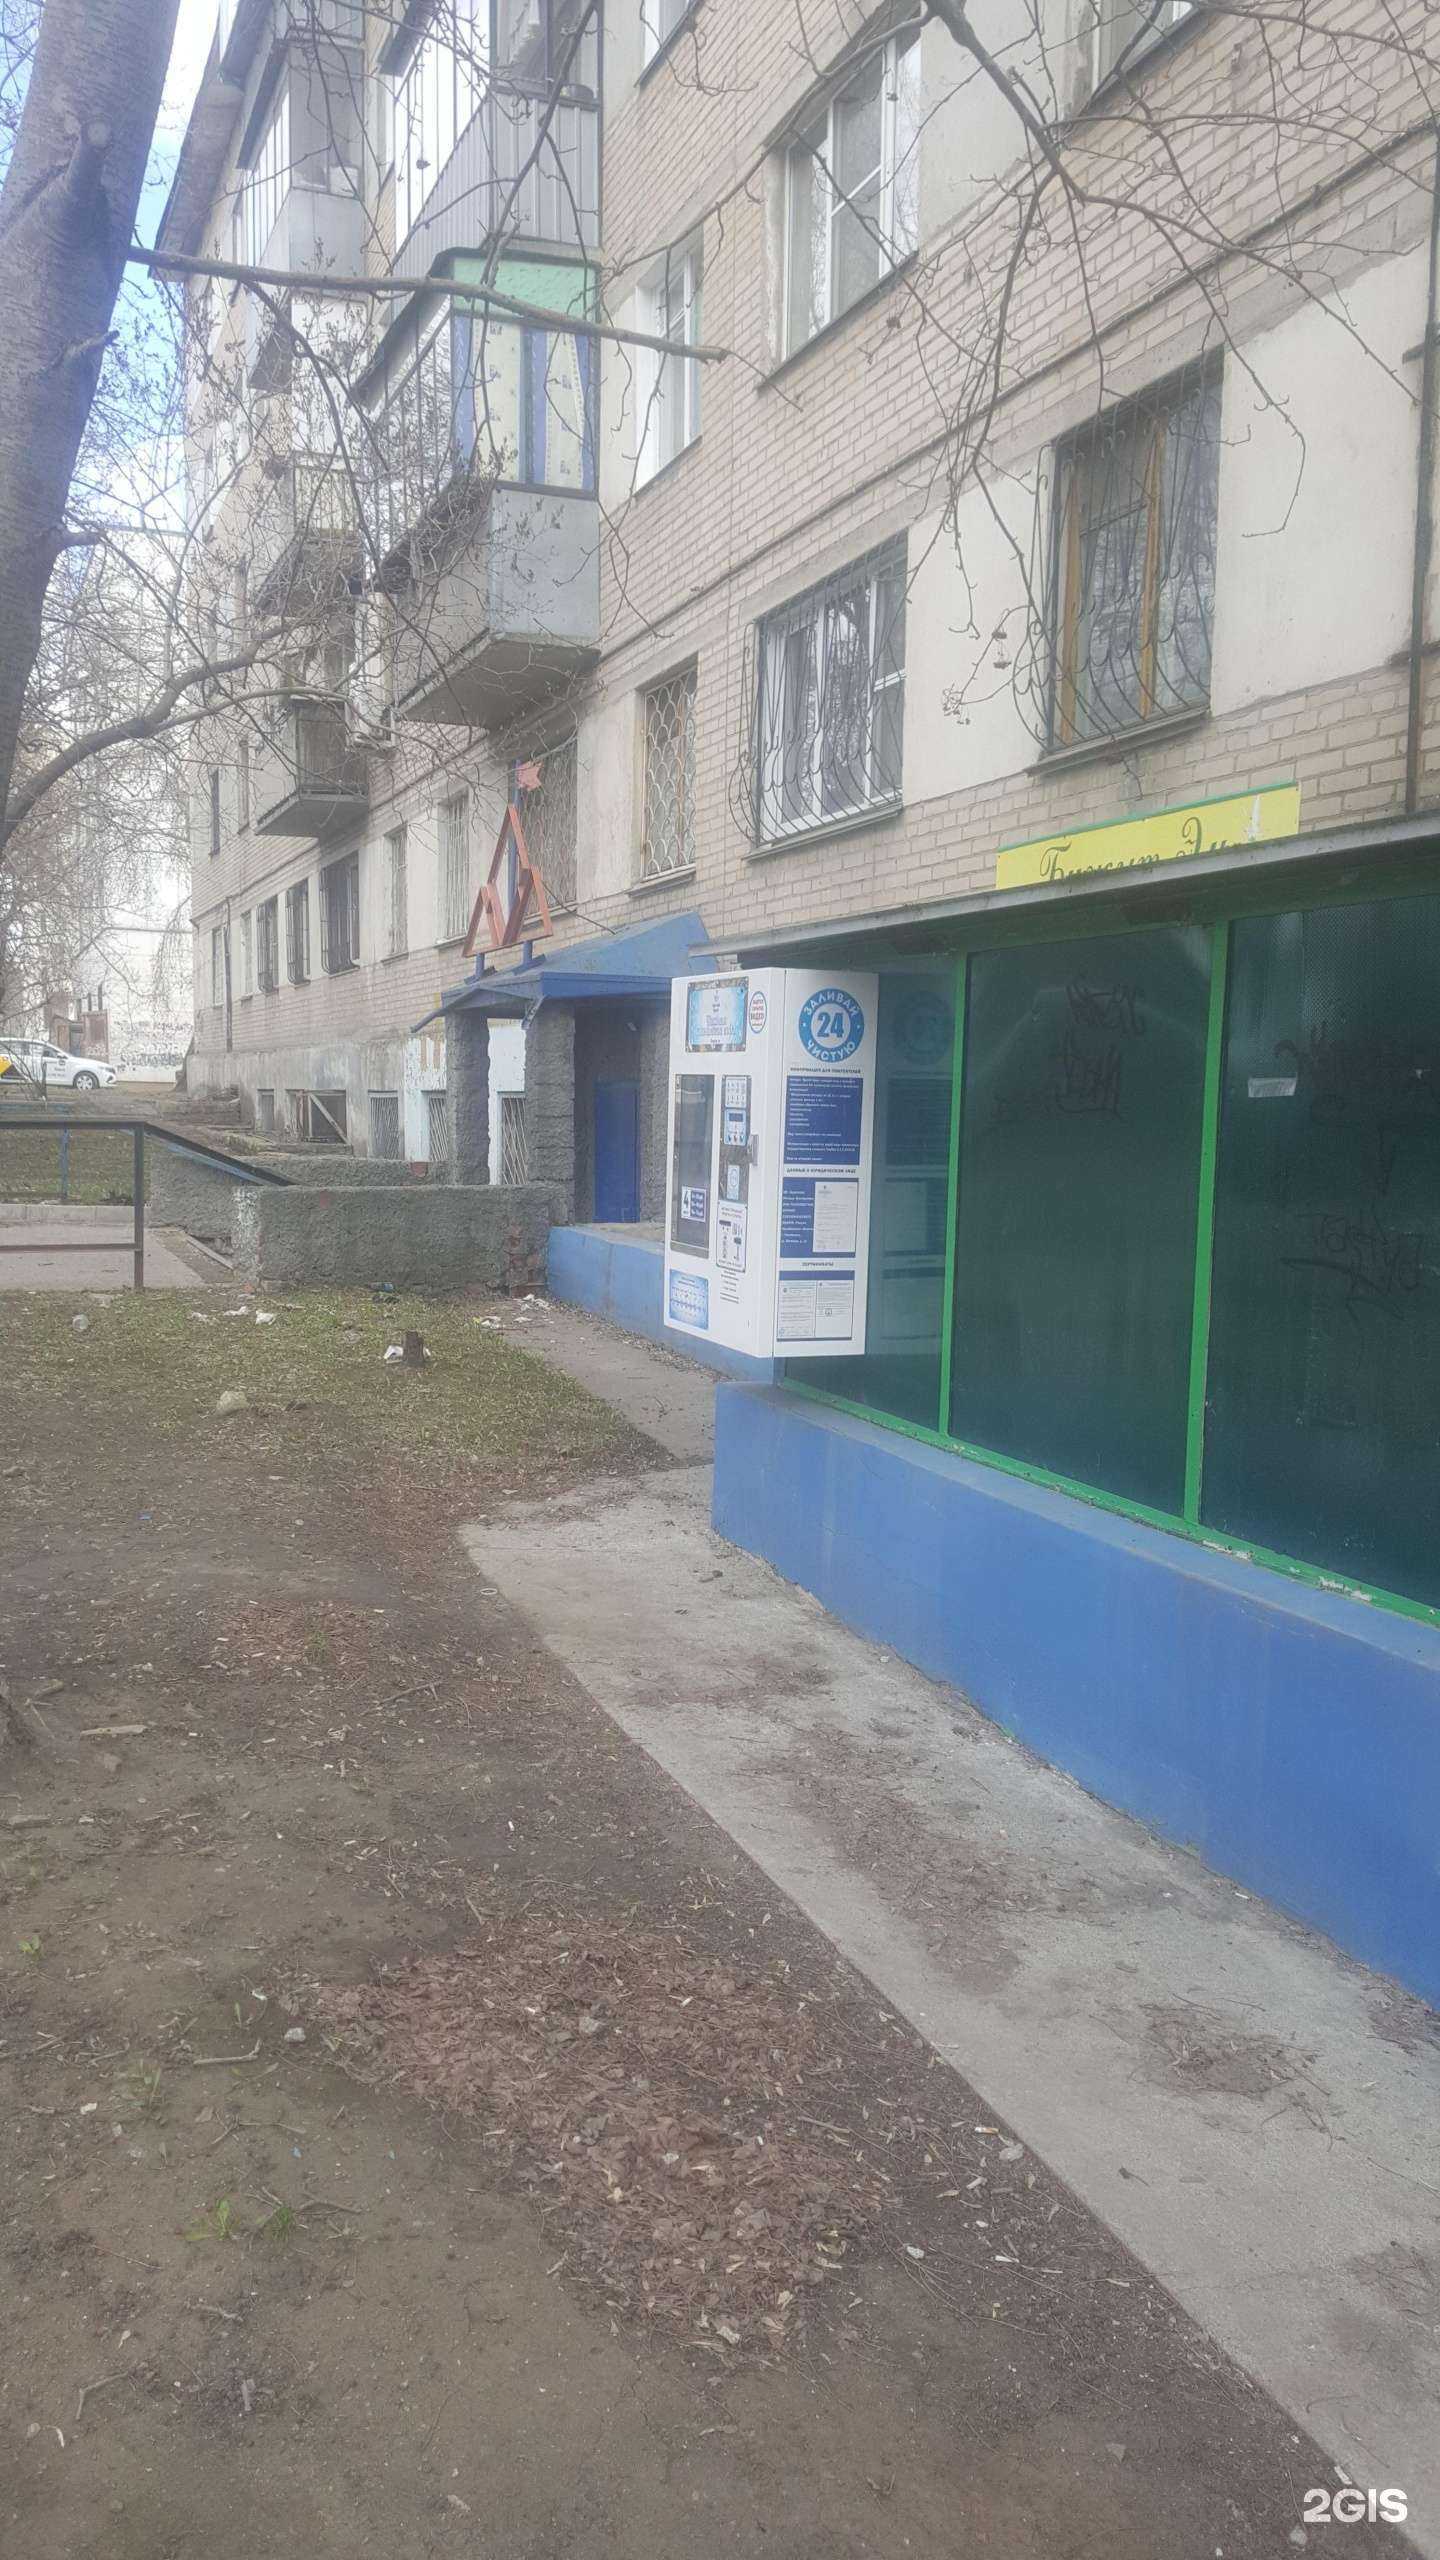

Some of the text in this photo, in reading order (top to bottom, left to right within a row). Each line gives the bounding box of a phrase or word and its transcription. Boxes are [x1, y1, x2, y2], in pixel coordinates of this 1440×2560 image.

[804, 991, 860, 1016] ЗАЛИВАЙ
[816, 1012, 844, 1038] 24
[807, 1040, 856, 1061] ЧИСТУЮ
